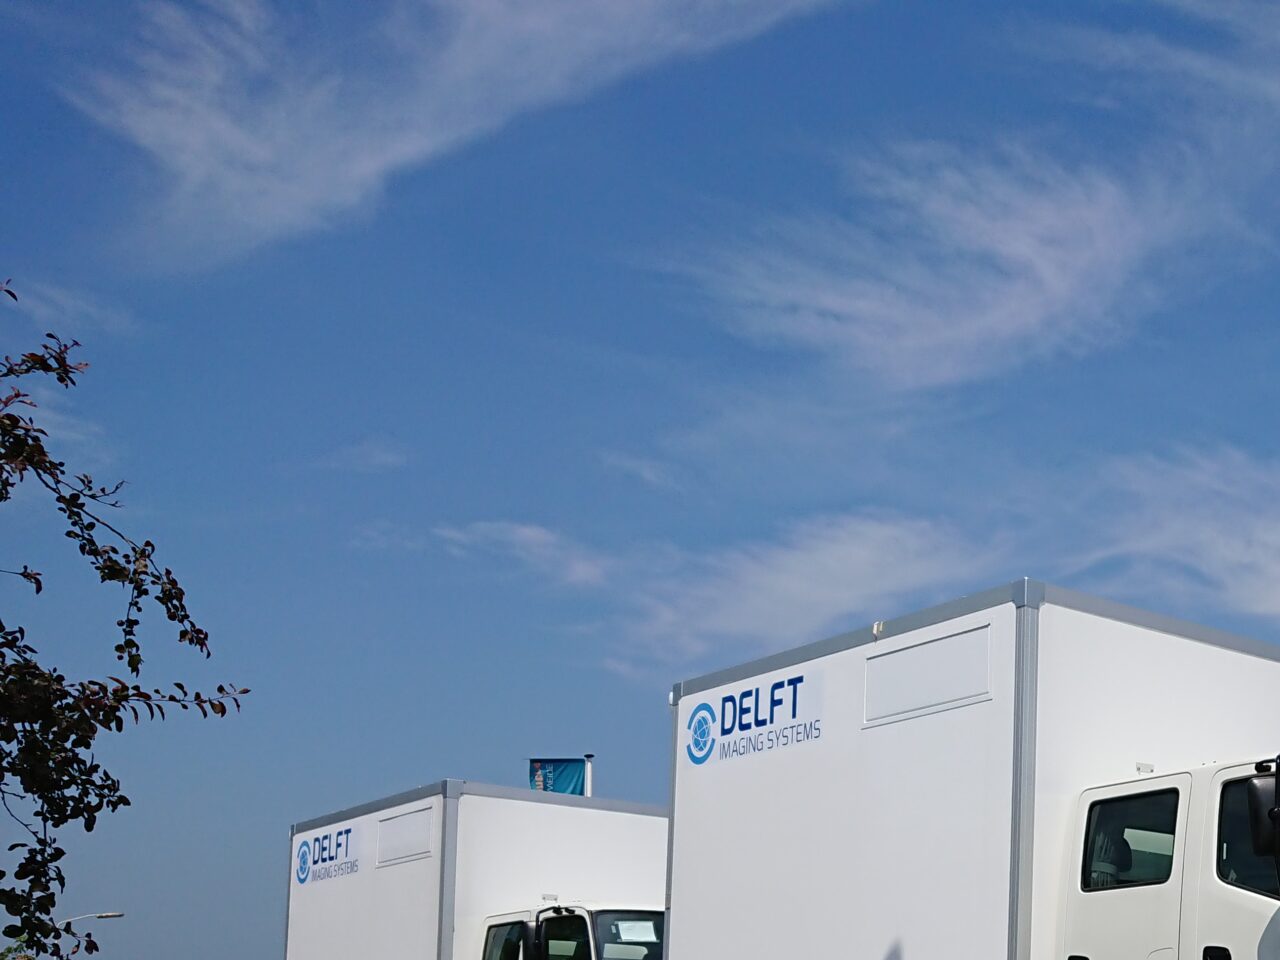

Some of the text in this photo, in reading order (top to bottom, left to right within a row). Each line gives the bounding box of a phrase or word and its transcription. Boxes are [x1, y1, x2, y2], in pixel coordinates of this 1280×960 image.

[720, 675, 804, 737] DELFT
[719, 719, 821, 761] IMAGING SYSTEMS
[312, 827, 352, 866] DELFT
[311, 858, 359, 882] IMAGING SYSTEMS
